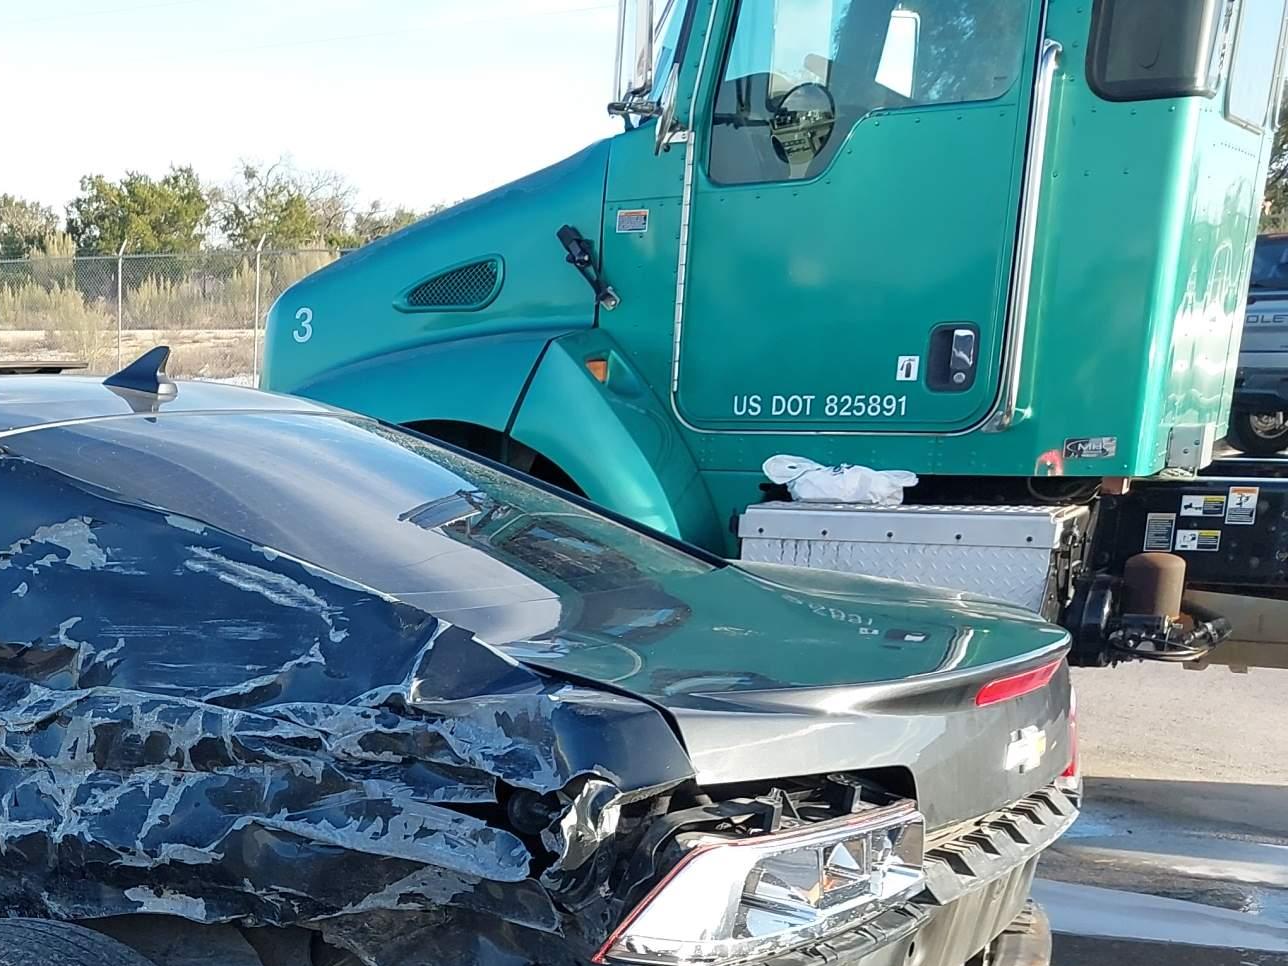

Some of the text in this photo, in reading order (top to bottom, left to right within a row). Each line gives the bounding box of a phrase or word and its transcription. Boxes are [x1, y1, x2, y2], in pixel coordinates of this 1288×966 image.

[293, 307, 313, 343] 3
[733, 395, 907, 416] US DOT 825891
